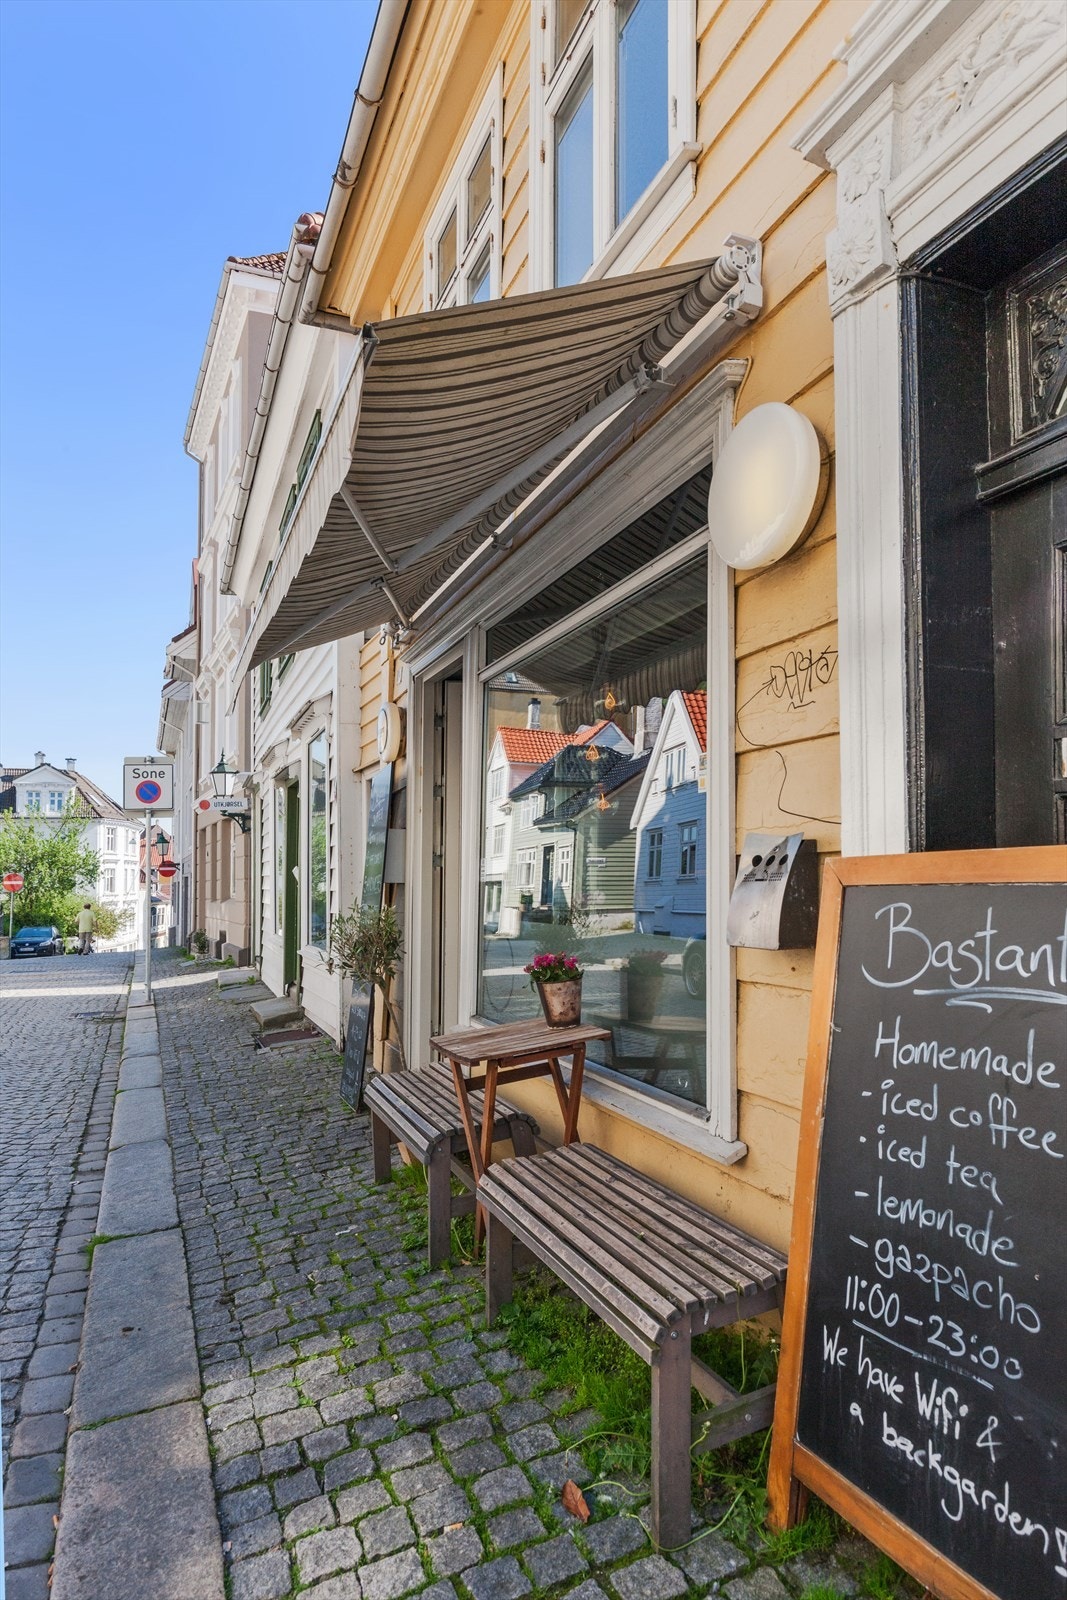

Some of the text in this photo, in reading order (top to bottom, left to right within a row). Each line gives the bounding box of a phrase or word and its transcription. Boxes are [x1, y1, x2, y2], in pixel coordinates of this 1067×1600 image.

[132, 768, 166, 779] Sone
[874, 1015, 1060, 1088] Homemade
[881, 1079, 938, 1121] iced
[950, 1092, 1064, 1158] coffee
[878, 1124, 926, 1169] iced
[947, 1145, 1003, 1205] tea
[877, 1175, 1020, 1266] lemonade
[823, 1324, 848, 1367] We
[858, 1335, 904, 1404] have
[976, 1416, 1002, 1462] &
[850, 1402, 864, 1426] a
